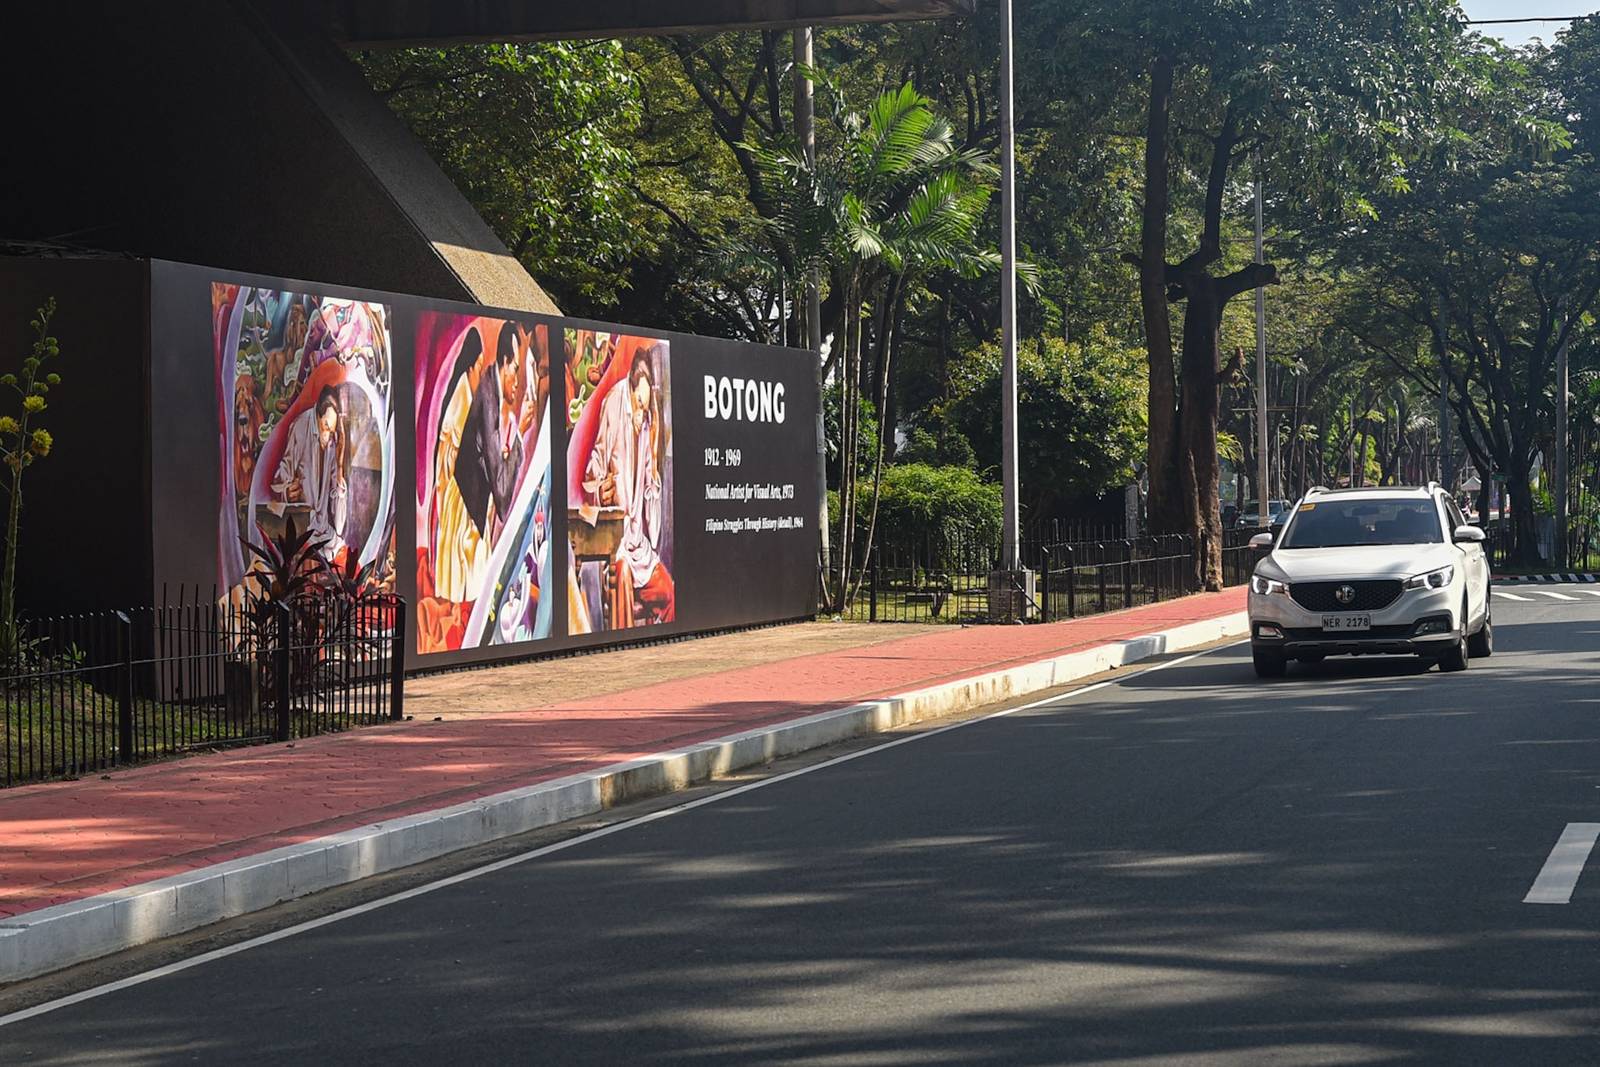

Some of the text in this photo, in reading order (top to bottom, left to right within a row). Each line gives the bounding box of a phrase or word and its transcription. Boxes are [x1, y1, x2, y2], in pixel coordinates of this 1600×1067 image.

[704, 375, 785, 424] BOTONG
[704, 448, 720, 466] 1912
[725, 449, 741, 466] 1969
[705, 483, 729, 500] National
[729, 483, 745, 500] Artist
[743, 483, 753, 503] for
[753, 483, 770, 499] Visual
[705, 518, 724, 534] Filipino
[723, 518, 744, 533] Struggles
[744, 517, 762, 532] Through
[762, 517, 777, 531] History
[1323, 617, 1369, 628] NER 2178
